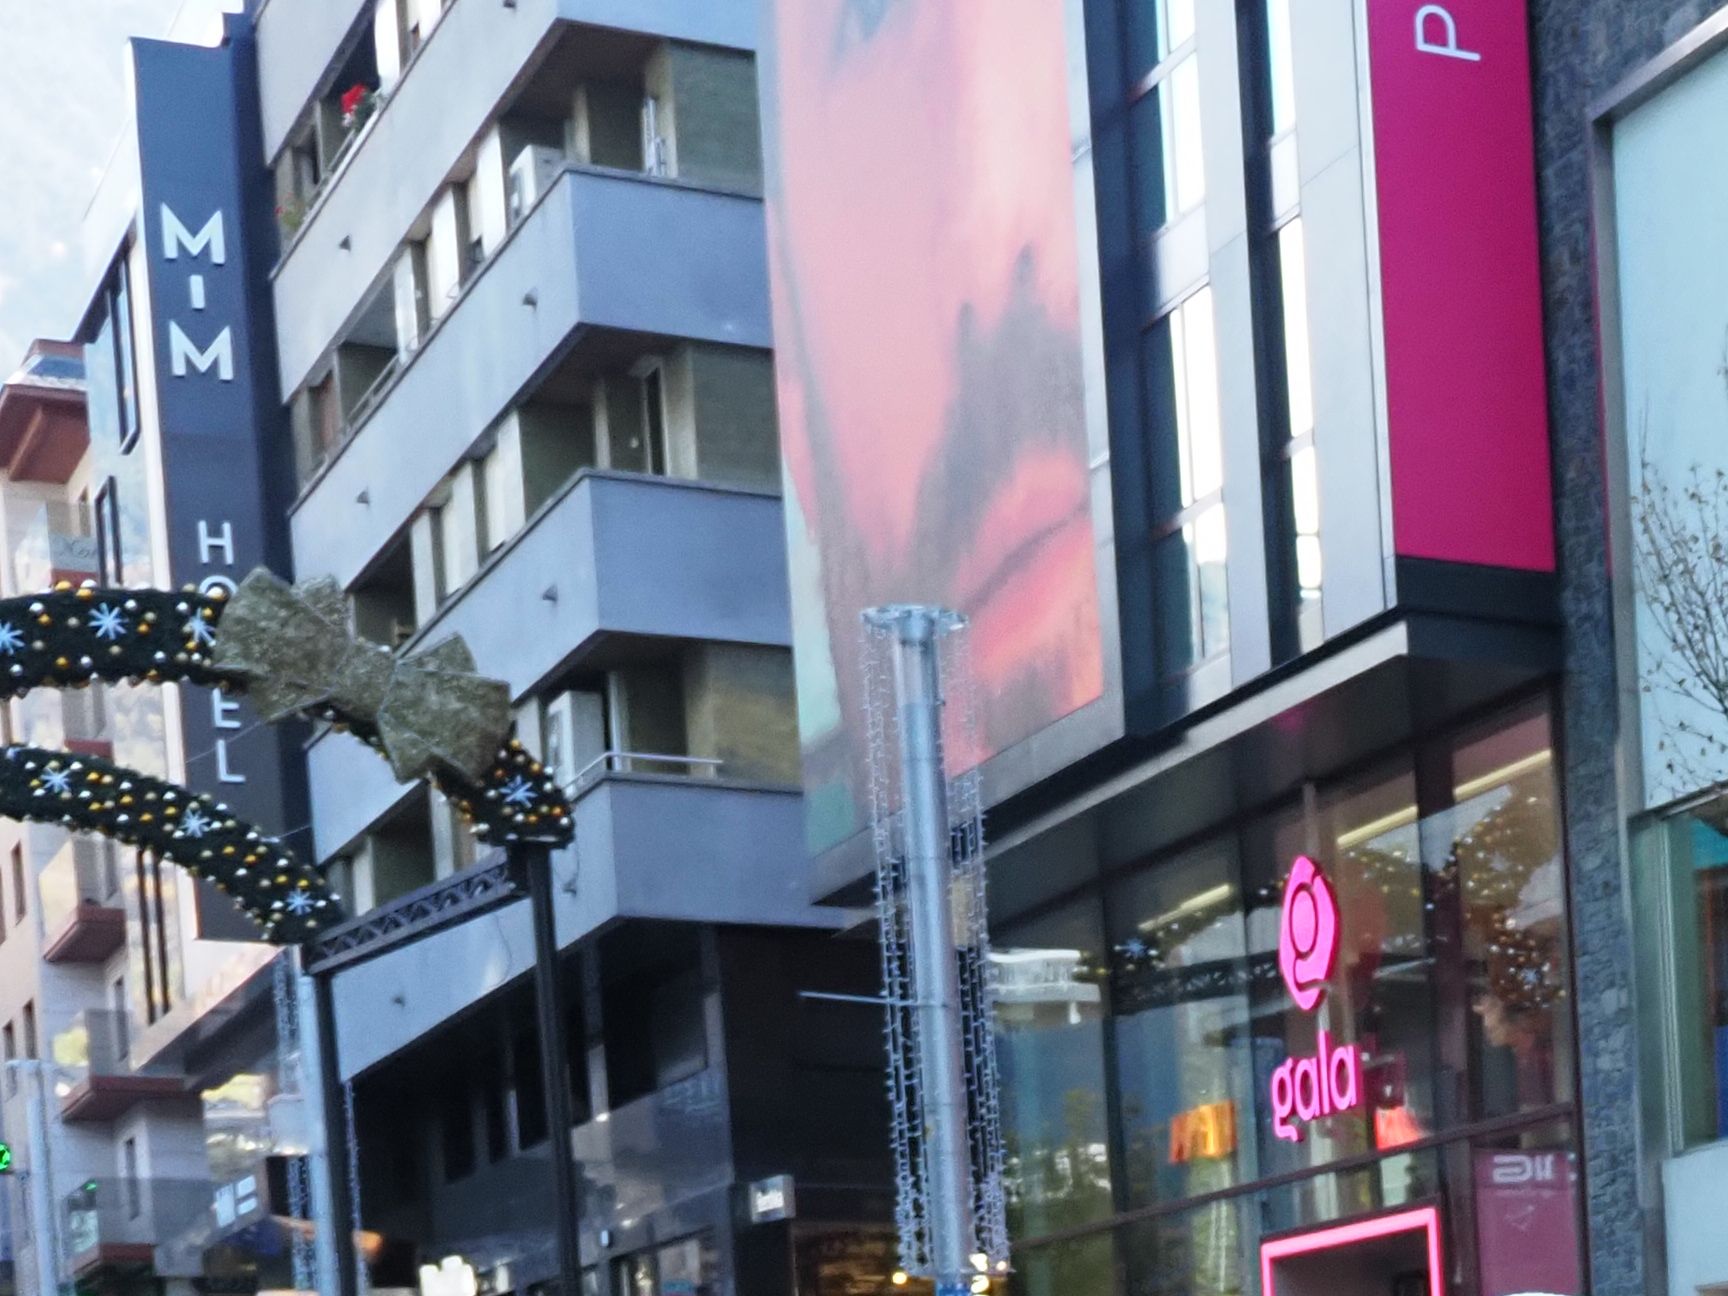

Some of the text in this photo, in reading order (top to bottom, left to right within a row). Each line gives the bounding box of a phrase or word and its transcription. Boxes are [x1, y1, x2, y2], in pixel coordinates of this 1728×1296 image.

[160, 202, 247, 783] MIM HEL
[1271, 1028, 1362, 1142] gala
